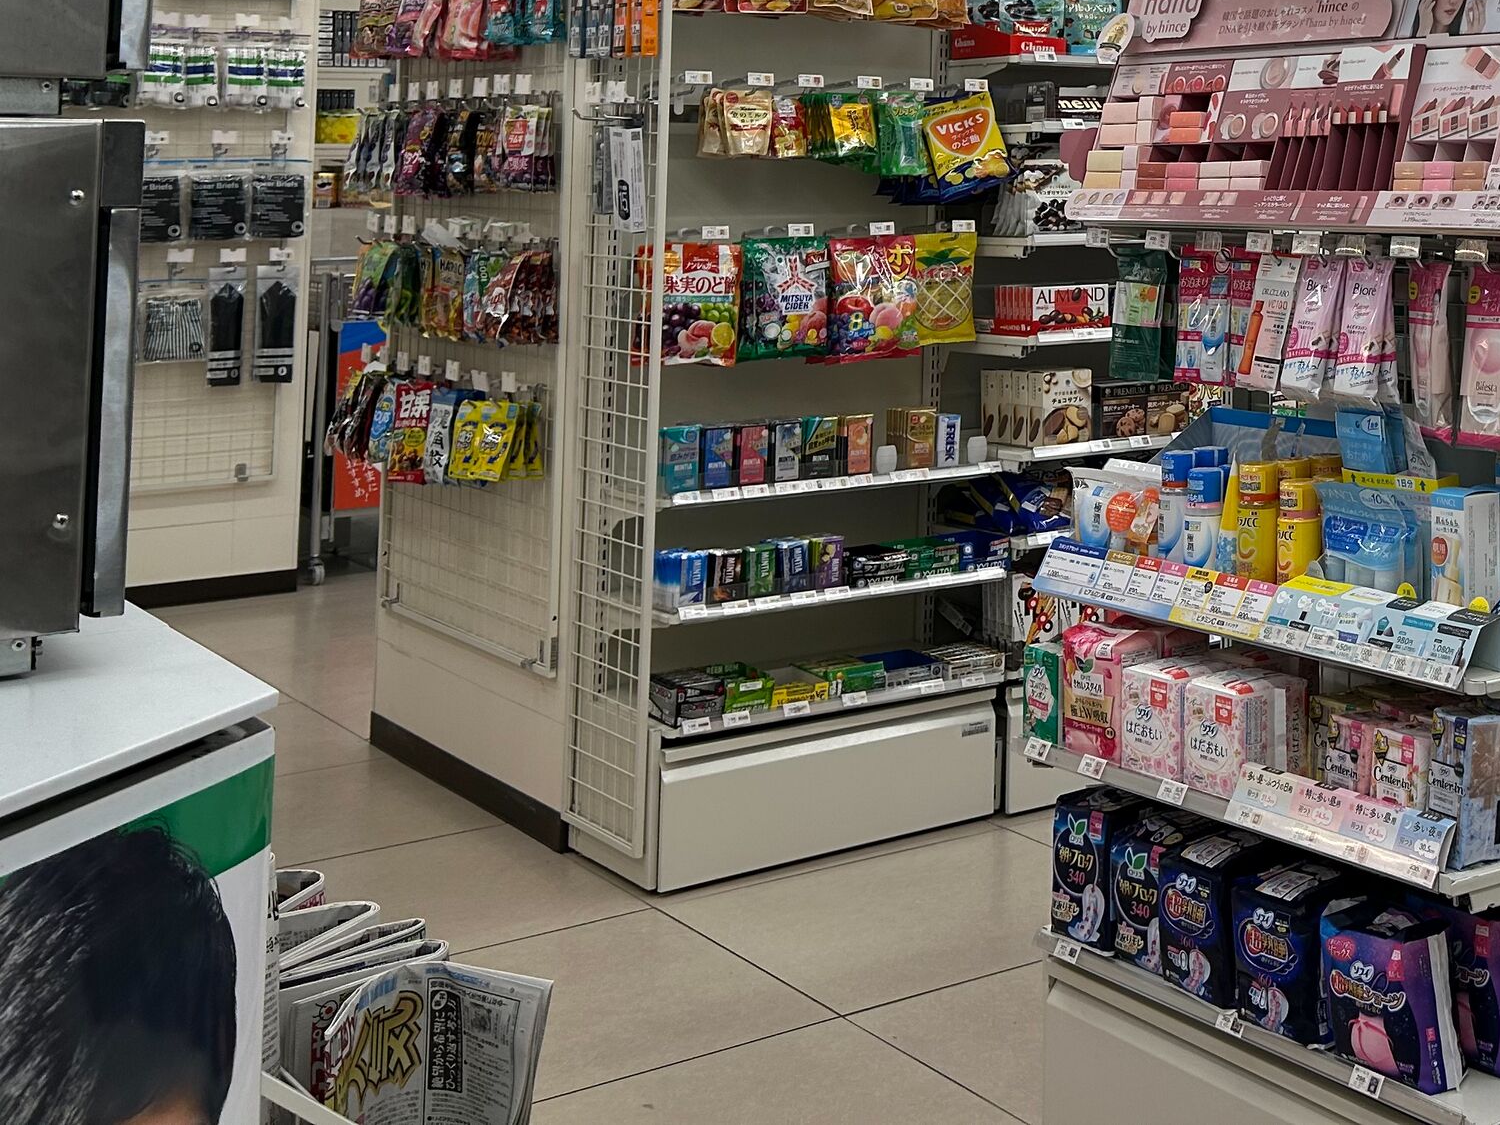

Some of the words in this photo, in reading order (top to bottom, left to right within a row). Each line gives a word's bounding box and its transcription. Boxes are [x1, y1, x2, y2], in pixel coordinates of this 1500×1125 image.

[1146, 24, 1157, 35] by
[1158, 21, 1187, 33] hince
[955, 38, 975, 47] Ghana
[1021, 41, 1055, 52] Ghana
[936, 113, 984, 135] VICKS
[951, 135, 981, 151] のど飴
[664, 276, 736, 294] 果実のど飴
[1180, 278, 1209, 287] お泊まり
[1352, 283, 1377, 296] Bioré
[779, 294, 813, 304] MITSUYA
[1036, 287, 1105, 304] ALMOND
[784, 302, 810, 310] CIDER
[1113, 386, 1147, 396] PREMIUM
[1157, 383, 1188, 392] PREMIUM
[1475, 381, 1498, 393] Bifesta
[400, 389, 431, 418] 甘栗
[1051, 396, 1084, 404] チョコサブレ
[944, 424, 960, 461] FRISK
[1125, 719, 1163, 741] はだおもい
[1190, 737, 1228, 758] はだおもい
[1068, 869, 1085, 885] 340
[1131, 903, 1150, 917] 340
